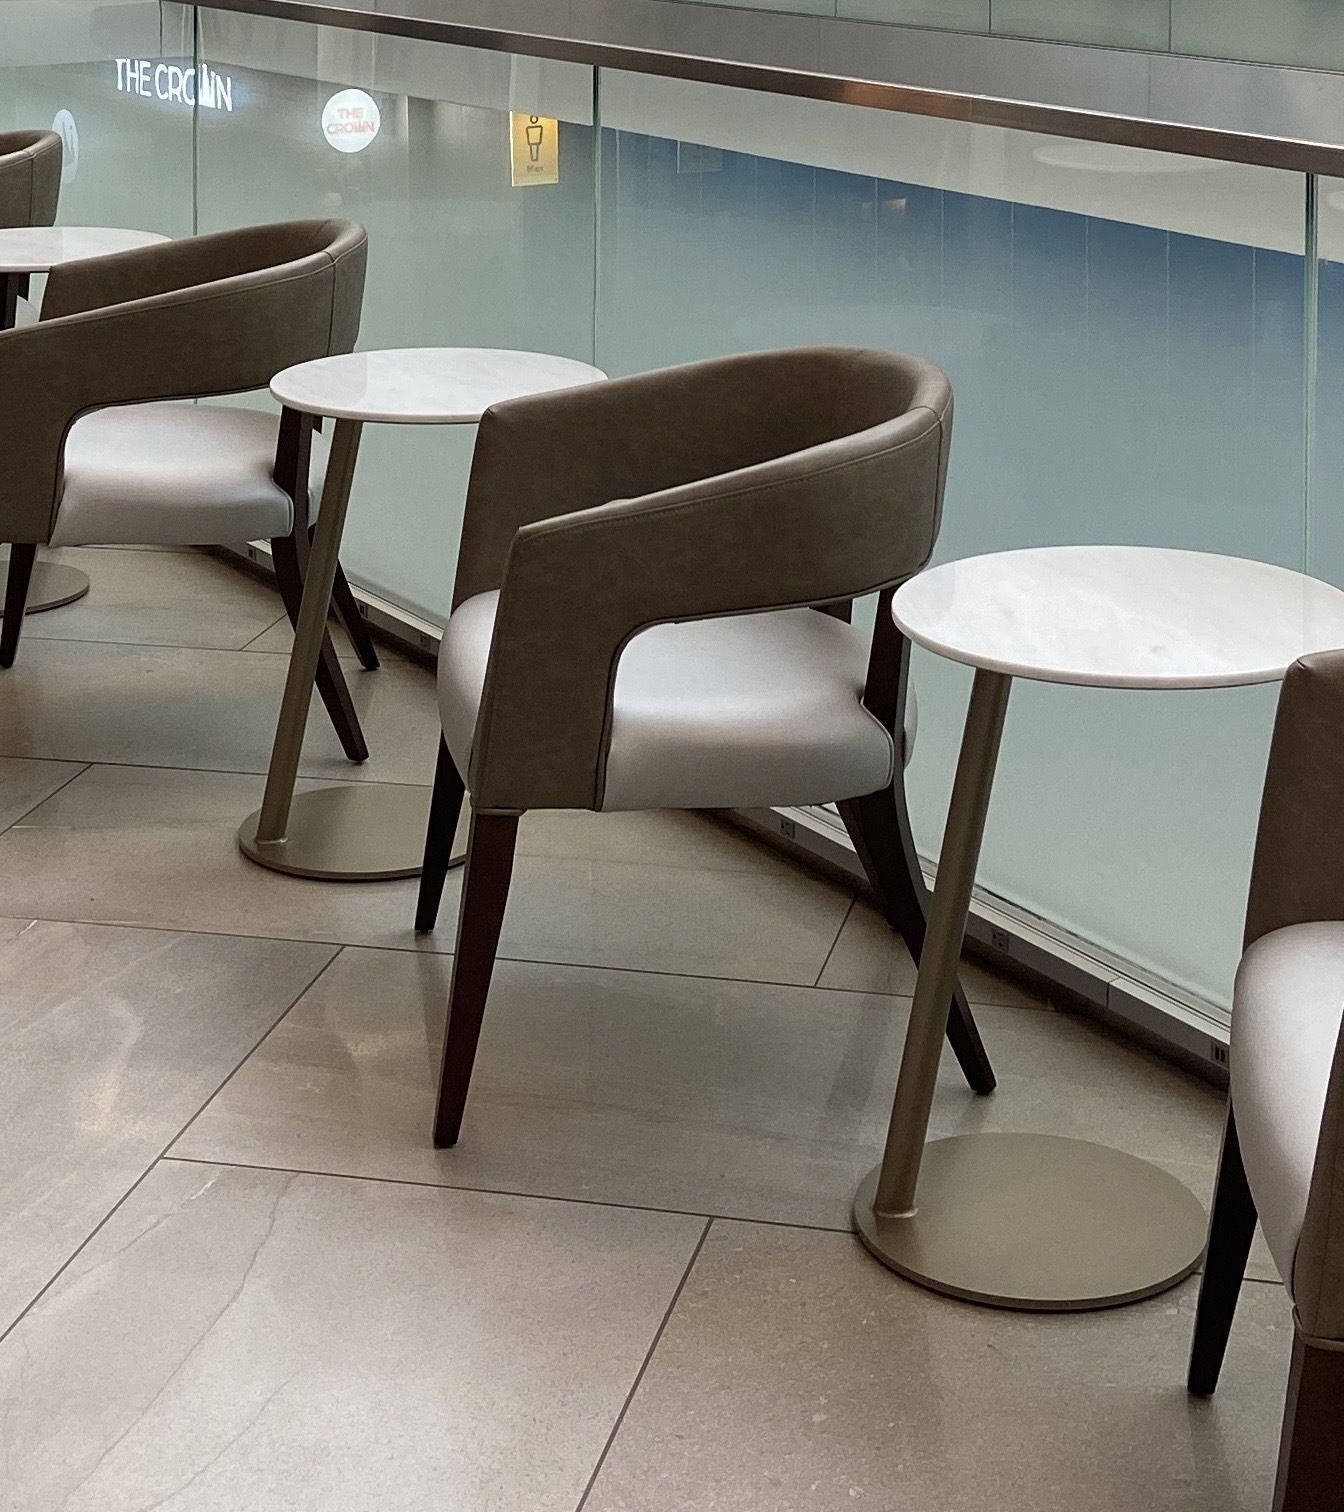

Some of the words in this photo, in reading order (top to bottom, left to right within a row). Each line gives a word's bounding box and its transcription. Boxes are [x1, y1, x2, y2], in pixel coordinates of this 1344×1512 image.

[115, 58, 152, 97] THE
[154, 63, 233, 112] CROWN
[337, 107, 364, 120] THE
[327, 120, 375, 135] CROWN
